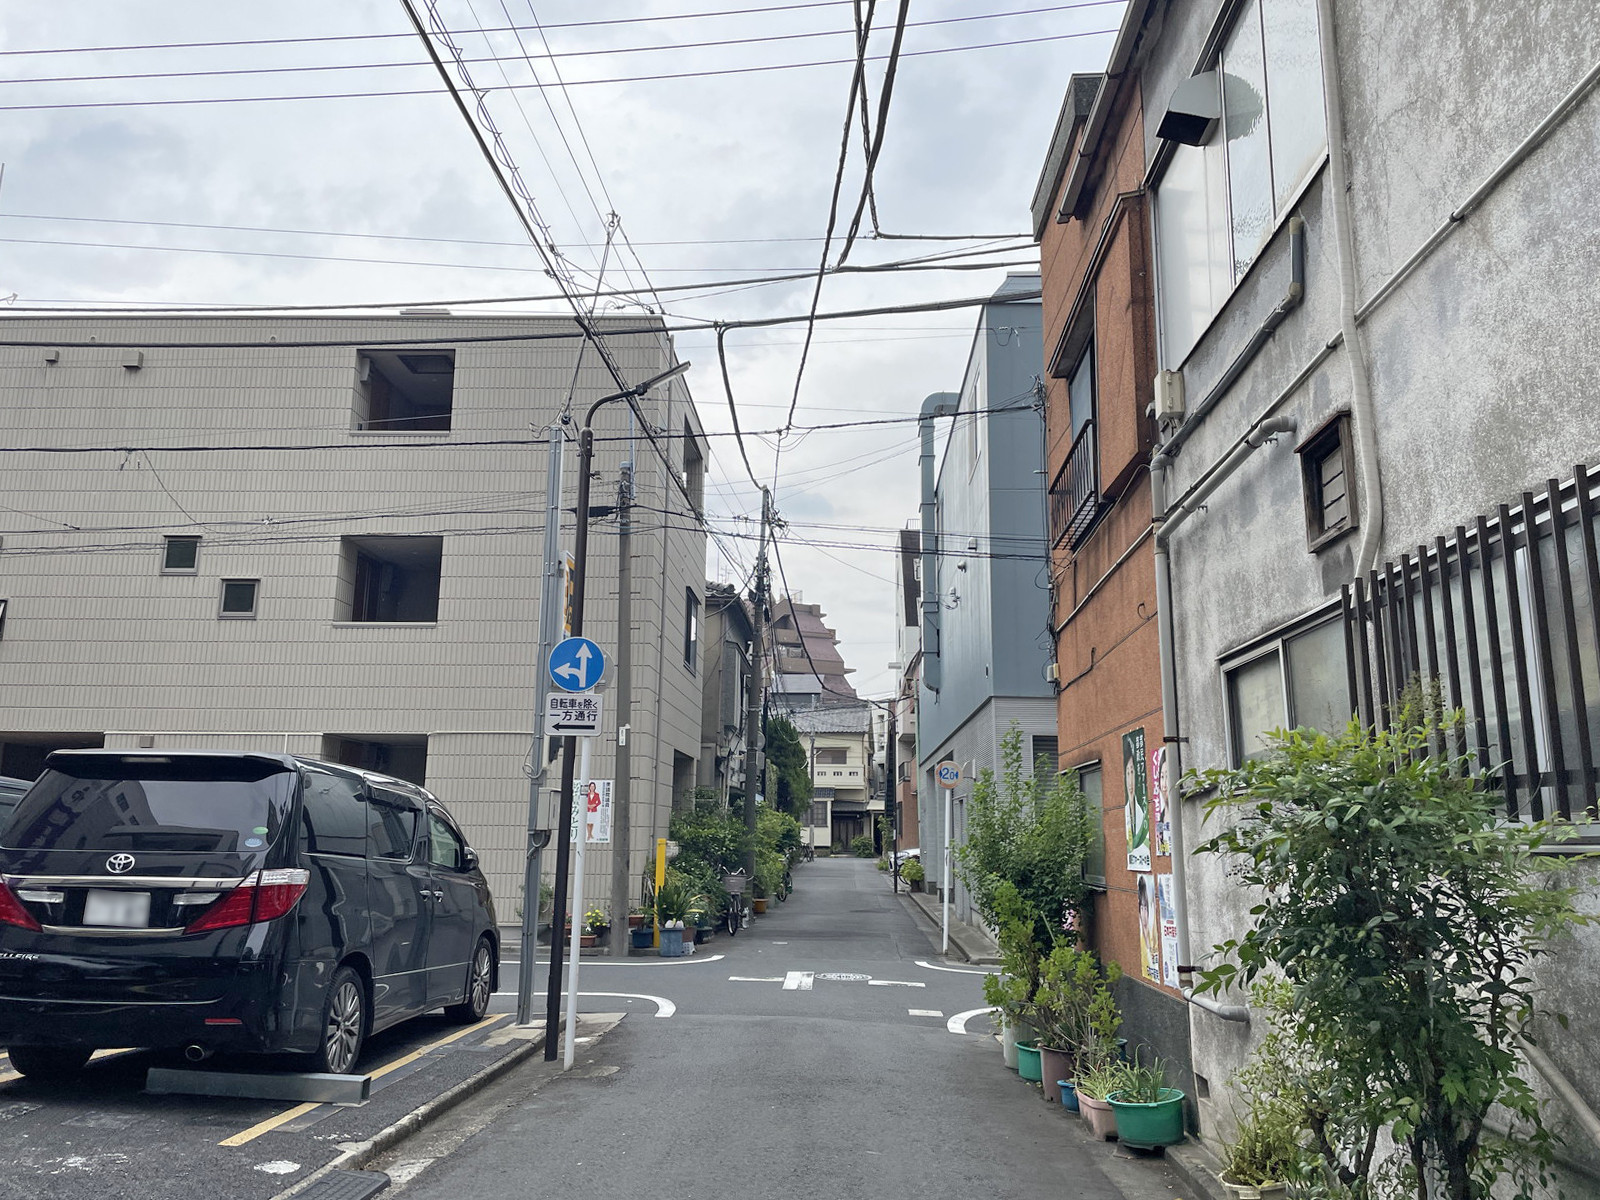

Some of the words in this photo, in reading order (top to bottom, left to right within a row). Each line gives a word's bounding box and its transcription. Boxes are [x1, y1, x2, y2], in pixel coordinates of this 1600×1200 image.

[551, 697, 598, 710] 自転車を除く
[550, 710, 598, 722] 一方通行
